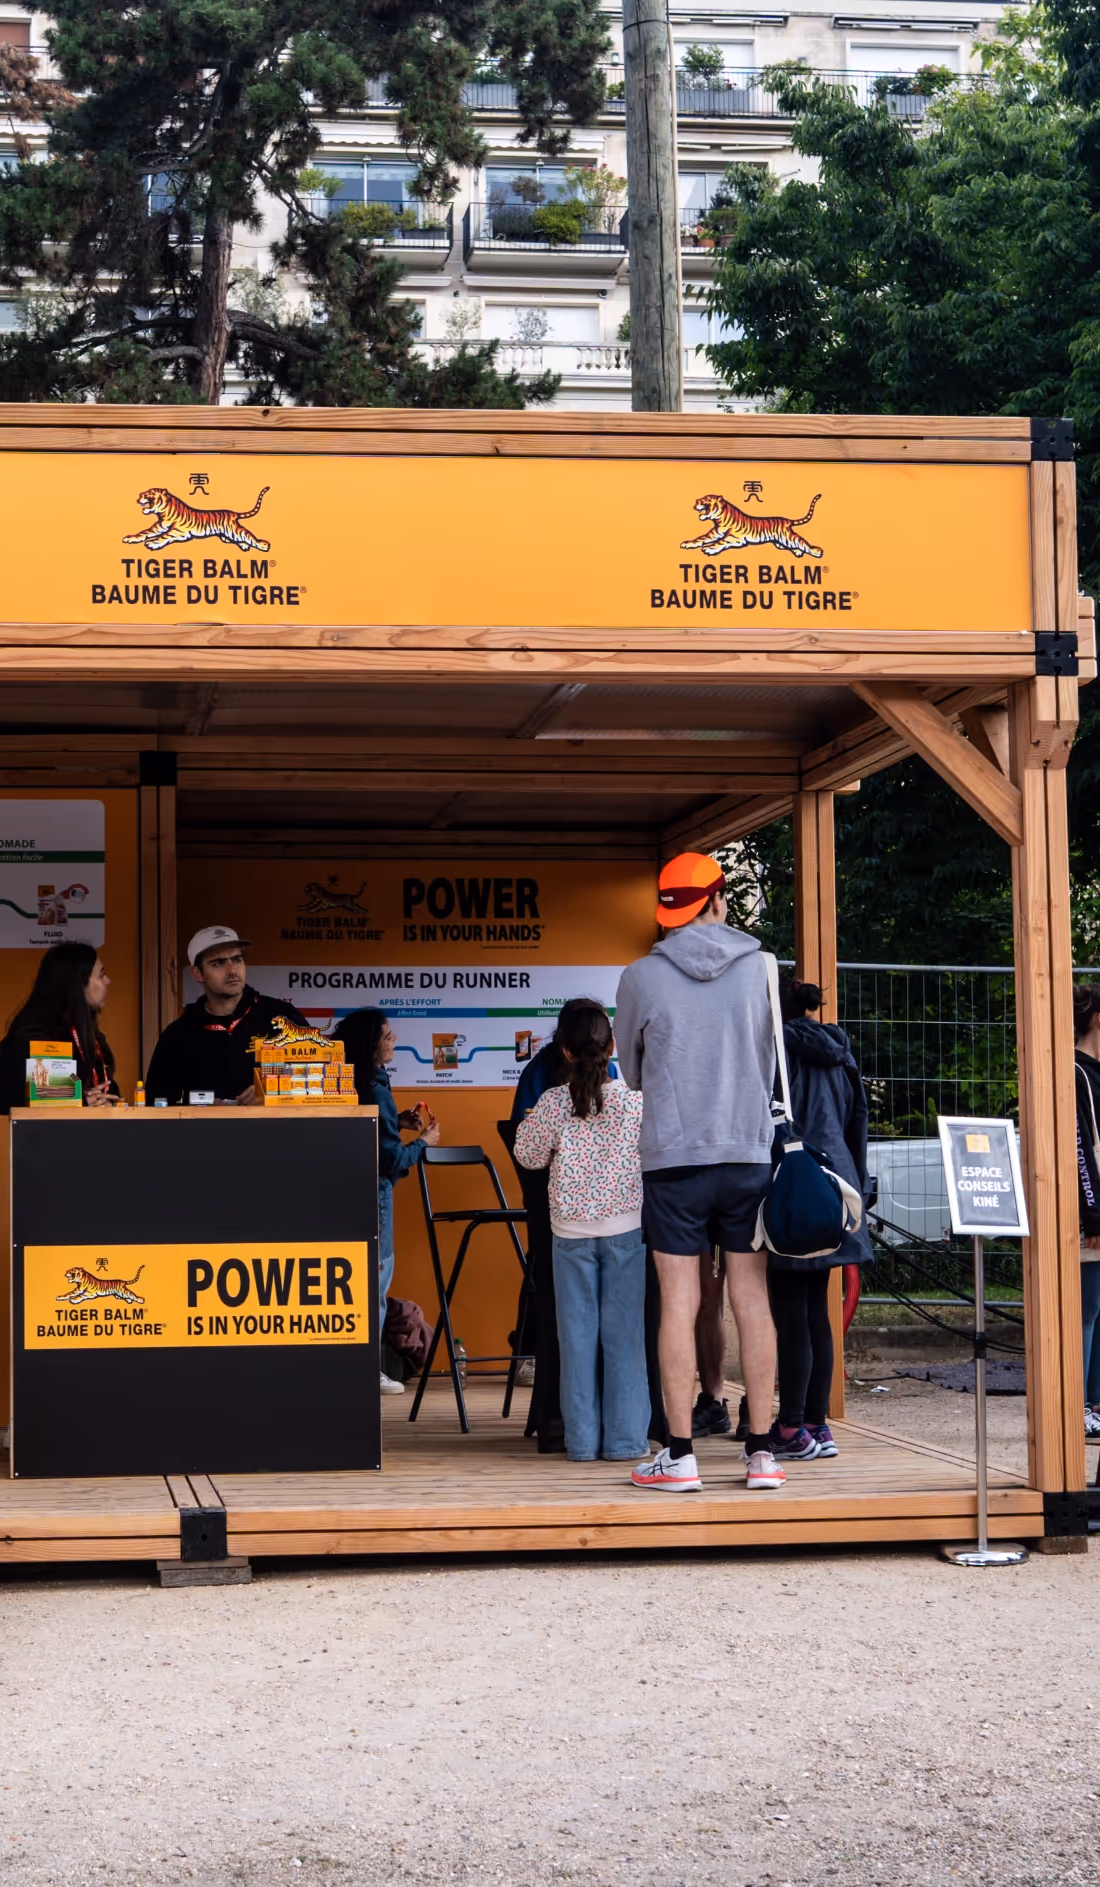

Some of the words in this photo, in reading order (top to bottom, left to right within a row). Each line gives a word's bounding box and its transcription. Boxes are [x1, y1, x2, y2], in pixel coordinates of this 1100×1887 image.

[121, 559, 193, 578] TIGER
[679, 564, 749, 583] TIGER
[92, 585, 176, 604] BAUME
[187, 585, 218, 605] DU
[651, 589, 732, 609] BAUME
[743, 590, 773, 609] DU
[22, 853, 43, 862] facile
[403, 878, 540, 919] POWER
[297, 917, 330, 927] TIGER
[281, 929, 322, 940] BAUME
[326, 929, 342, 940] DU
[403, 924, 417, 941] IS
[420, 924, 437, 941] IN
[440, 924, 483, 941] YOUR
[288, 972, 414, 989] PROGRAMME
[420, 972, 446, 988] DU
[453, 972, 530, 988] RUNNER
[379, 997, 404, 1006] APRÈS
[406, 998, 441, 1006] L'EFFORT
[542, 998, 571, 1006] NOMA
[397, 1009, 413, 1017] Effet
[413, 1009, 427, 1017] froid
[291, 1047, 317, 1056] BALM
[961, 1166, 1002, 1178] ESPACE
[1076, 1148, 1095, 1207] CONTROL
[957, 1181, 1011, 1193] CONSEILS
[973, 1195, 999, 1207] KINÉ
[187, 1257, 354, 1308] POWER
[55, 1309, 98, 1321] TIGER
[37, 1325, 88, 1337] BAUME
[94, 1324, 113, 1336] DU
[187, 1316, 204, 1336] IS
[209, 1315, 228, 1335] IN
[232, 1315, 284, 1335] YOUR
